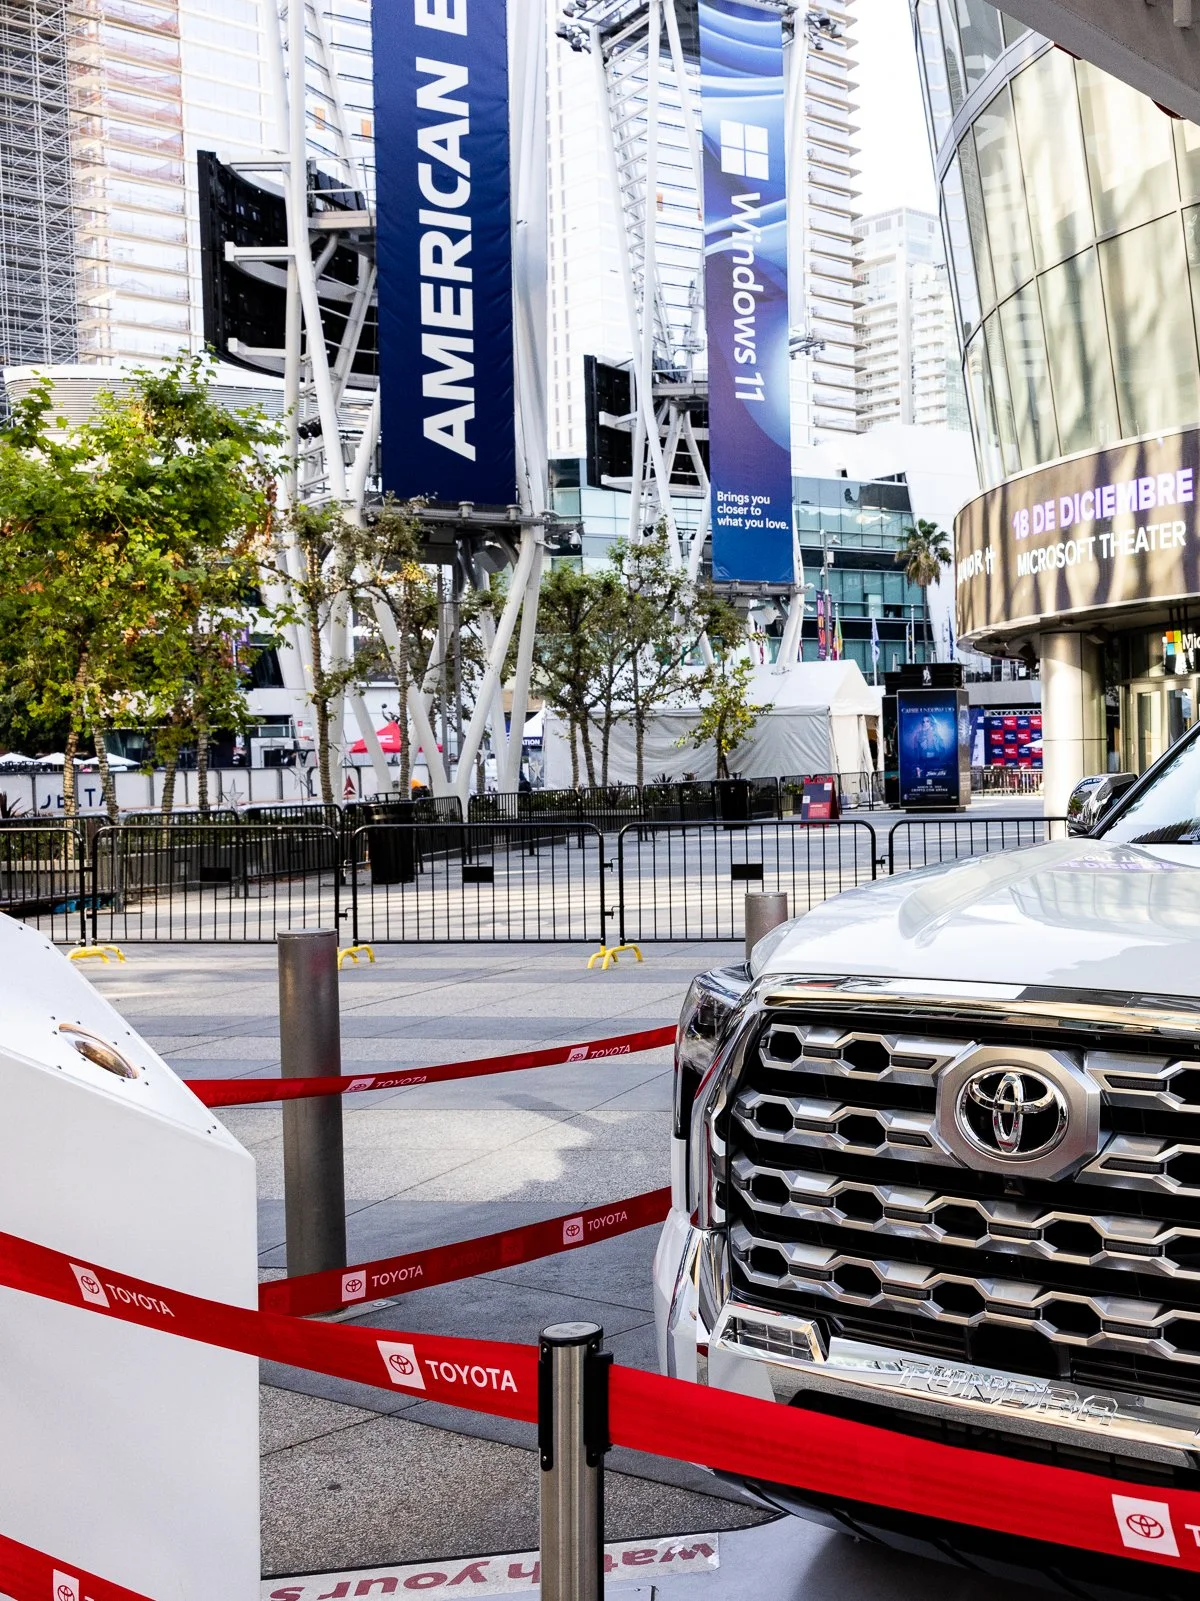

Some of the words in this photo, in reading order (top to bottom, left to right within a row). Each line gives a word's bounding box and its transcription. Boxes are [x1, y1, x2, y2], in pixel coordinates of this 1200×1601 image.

[415, 56, 476, 462] AMERICAN
[731, 192, 764, 365] Windows
[735, 372, 765, 401] 11
[717, 491, 749, 505] Brings
[751, 495, 770, 506] you
[717, 503, 748, 515] closer
[750, 505, 762, 515] to
[1012, 508, 1030, 540] 18
[1033, 500, 1056, 535] DE
[1060, 468, 1194, 528] DICIEMBRE
[717, 515, 743, 527] what
[745, 519, 763, 529] you
[766, 518, 789, 529] love.
[1017, 536, 1096, 577] MICROSOFT
[1100, 520, 1187, 559] THEATER
[590, 1044, 631, 1059] TOYOTA
[376, 1075, 427, 1088] TOYOTA
[587, 1211, 628, 1231] TOYOTA
[371, 1265, 423, 1287] TOYOTA
[105, 1283, 175, 1318] TOYOTA
[425, 1360, 518, 1393] TOYOTA
[899, 1357, 1119, 1427] TUNDRA
